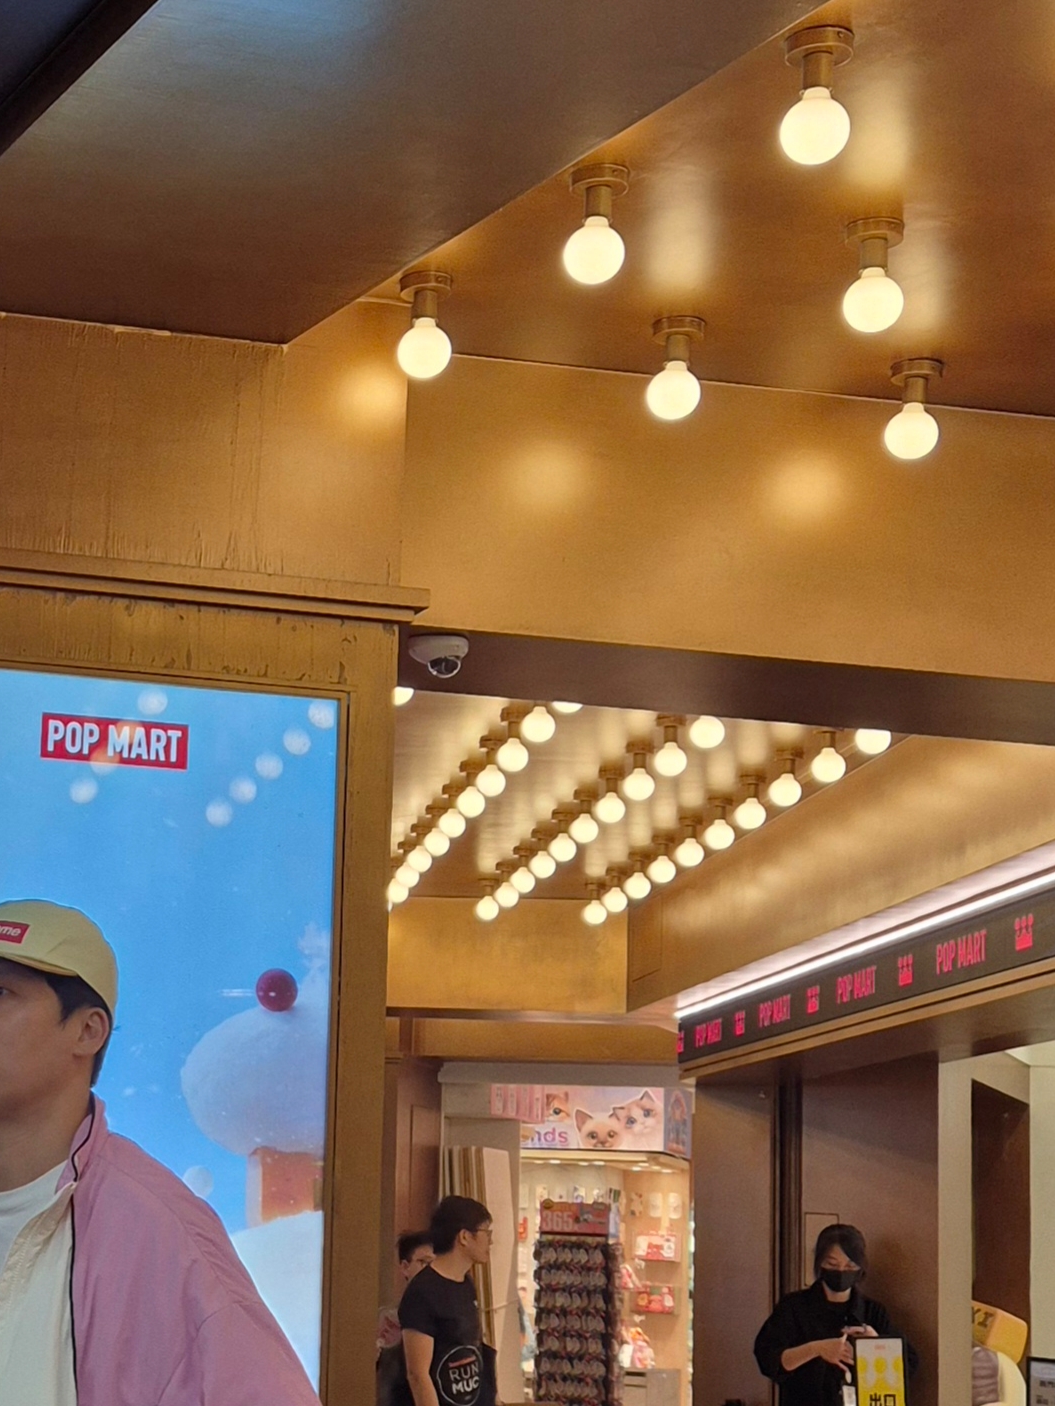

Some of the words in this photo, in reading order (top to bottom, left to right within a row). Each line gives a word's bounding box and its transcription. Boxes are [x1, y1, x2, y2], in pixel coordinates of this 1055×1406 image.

[47, 719, 100, 755] POP
[107, 724, 182, 763] MART
[936, 939, 956, 975] POP
[957, 928, 988, 968] MART
[449, 1361, 479, 1381] RUN
